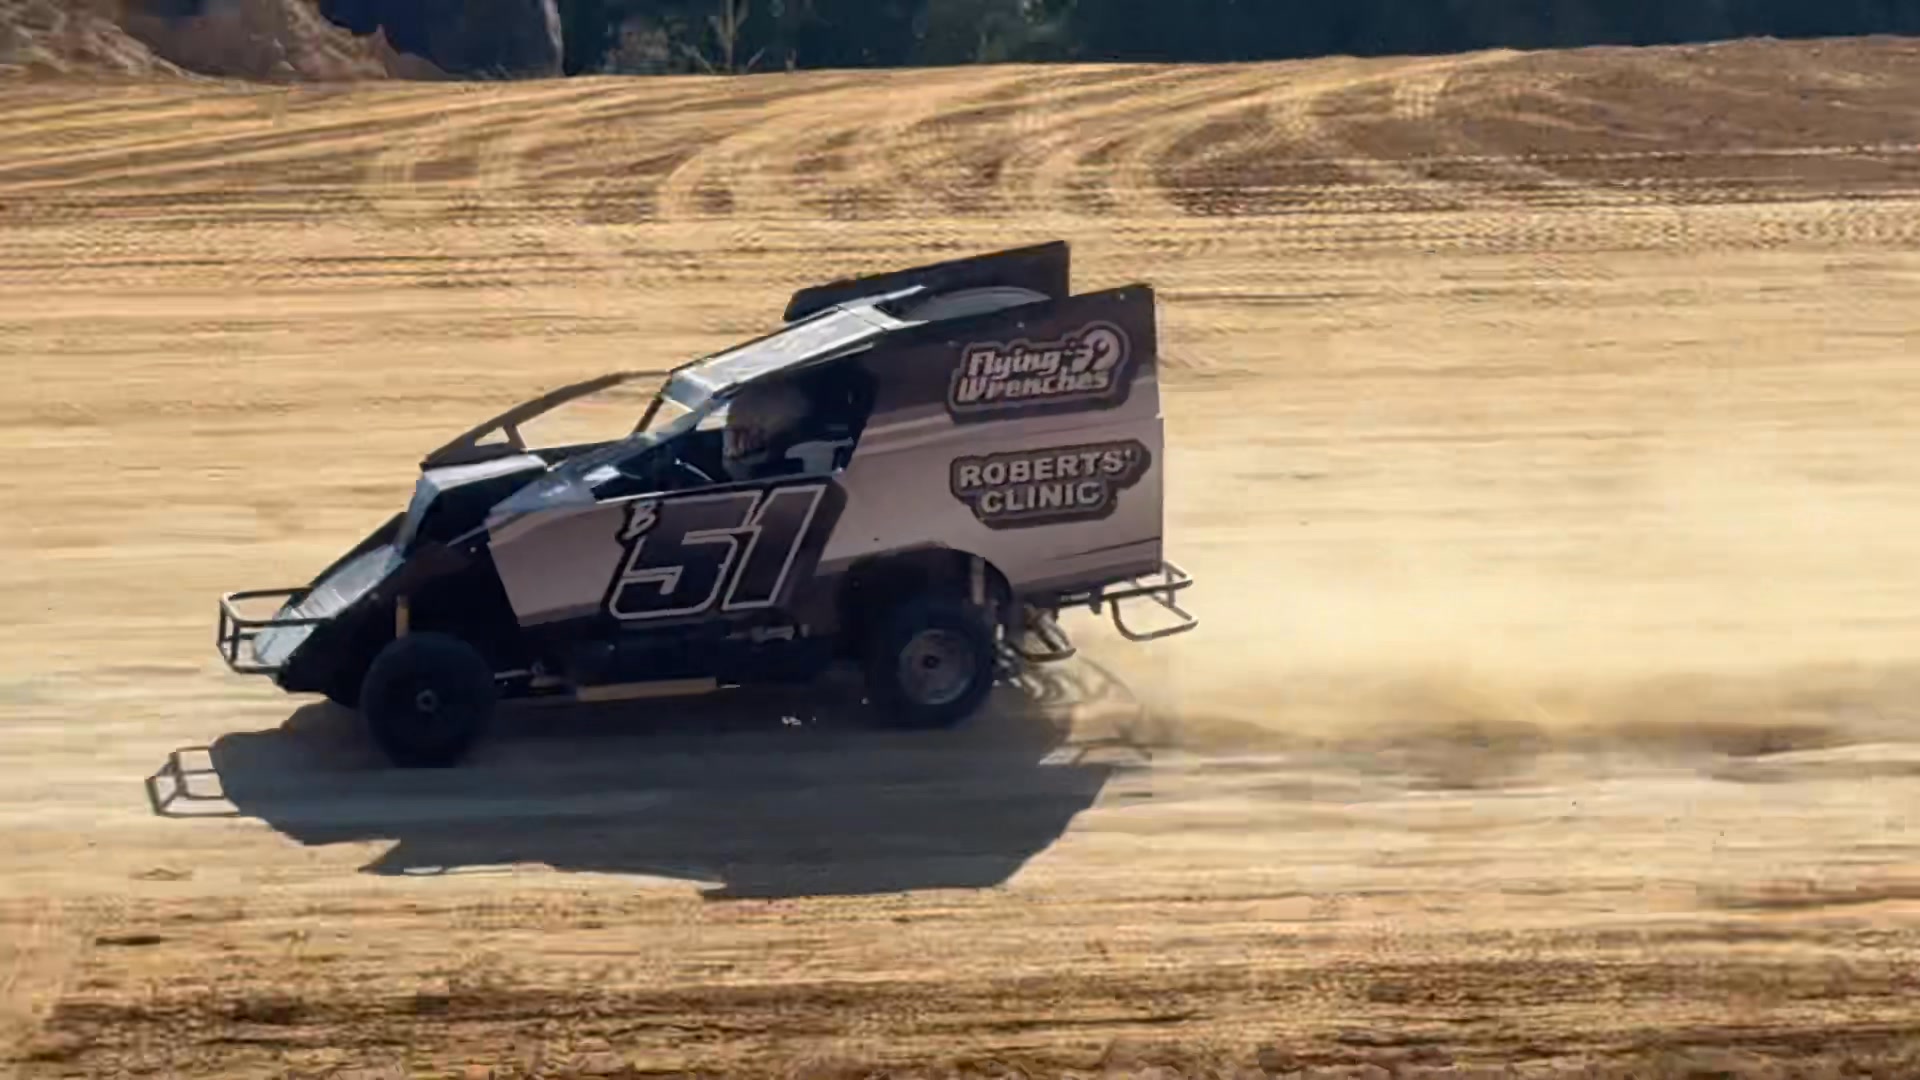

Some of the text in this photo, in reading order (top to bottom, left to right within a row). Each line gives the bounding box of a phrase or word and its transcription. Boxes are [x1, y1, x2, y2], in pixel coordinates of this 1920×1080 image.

[967, 348, 1063, 380] Flying
[957, 367, 1110, 401] Wrenches
[959, 450, 1132, 487] ROBERTS'
[981, 482, 1101, 513] CLINIC
[608, 484, 827, 620] 51
